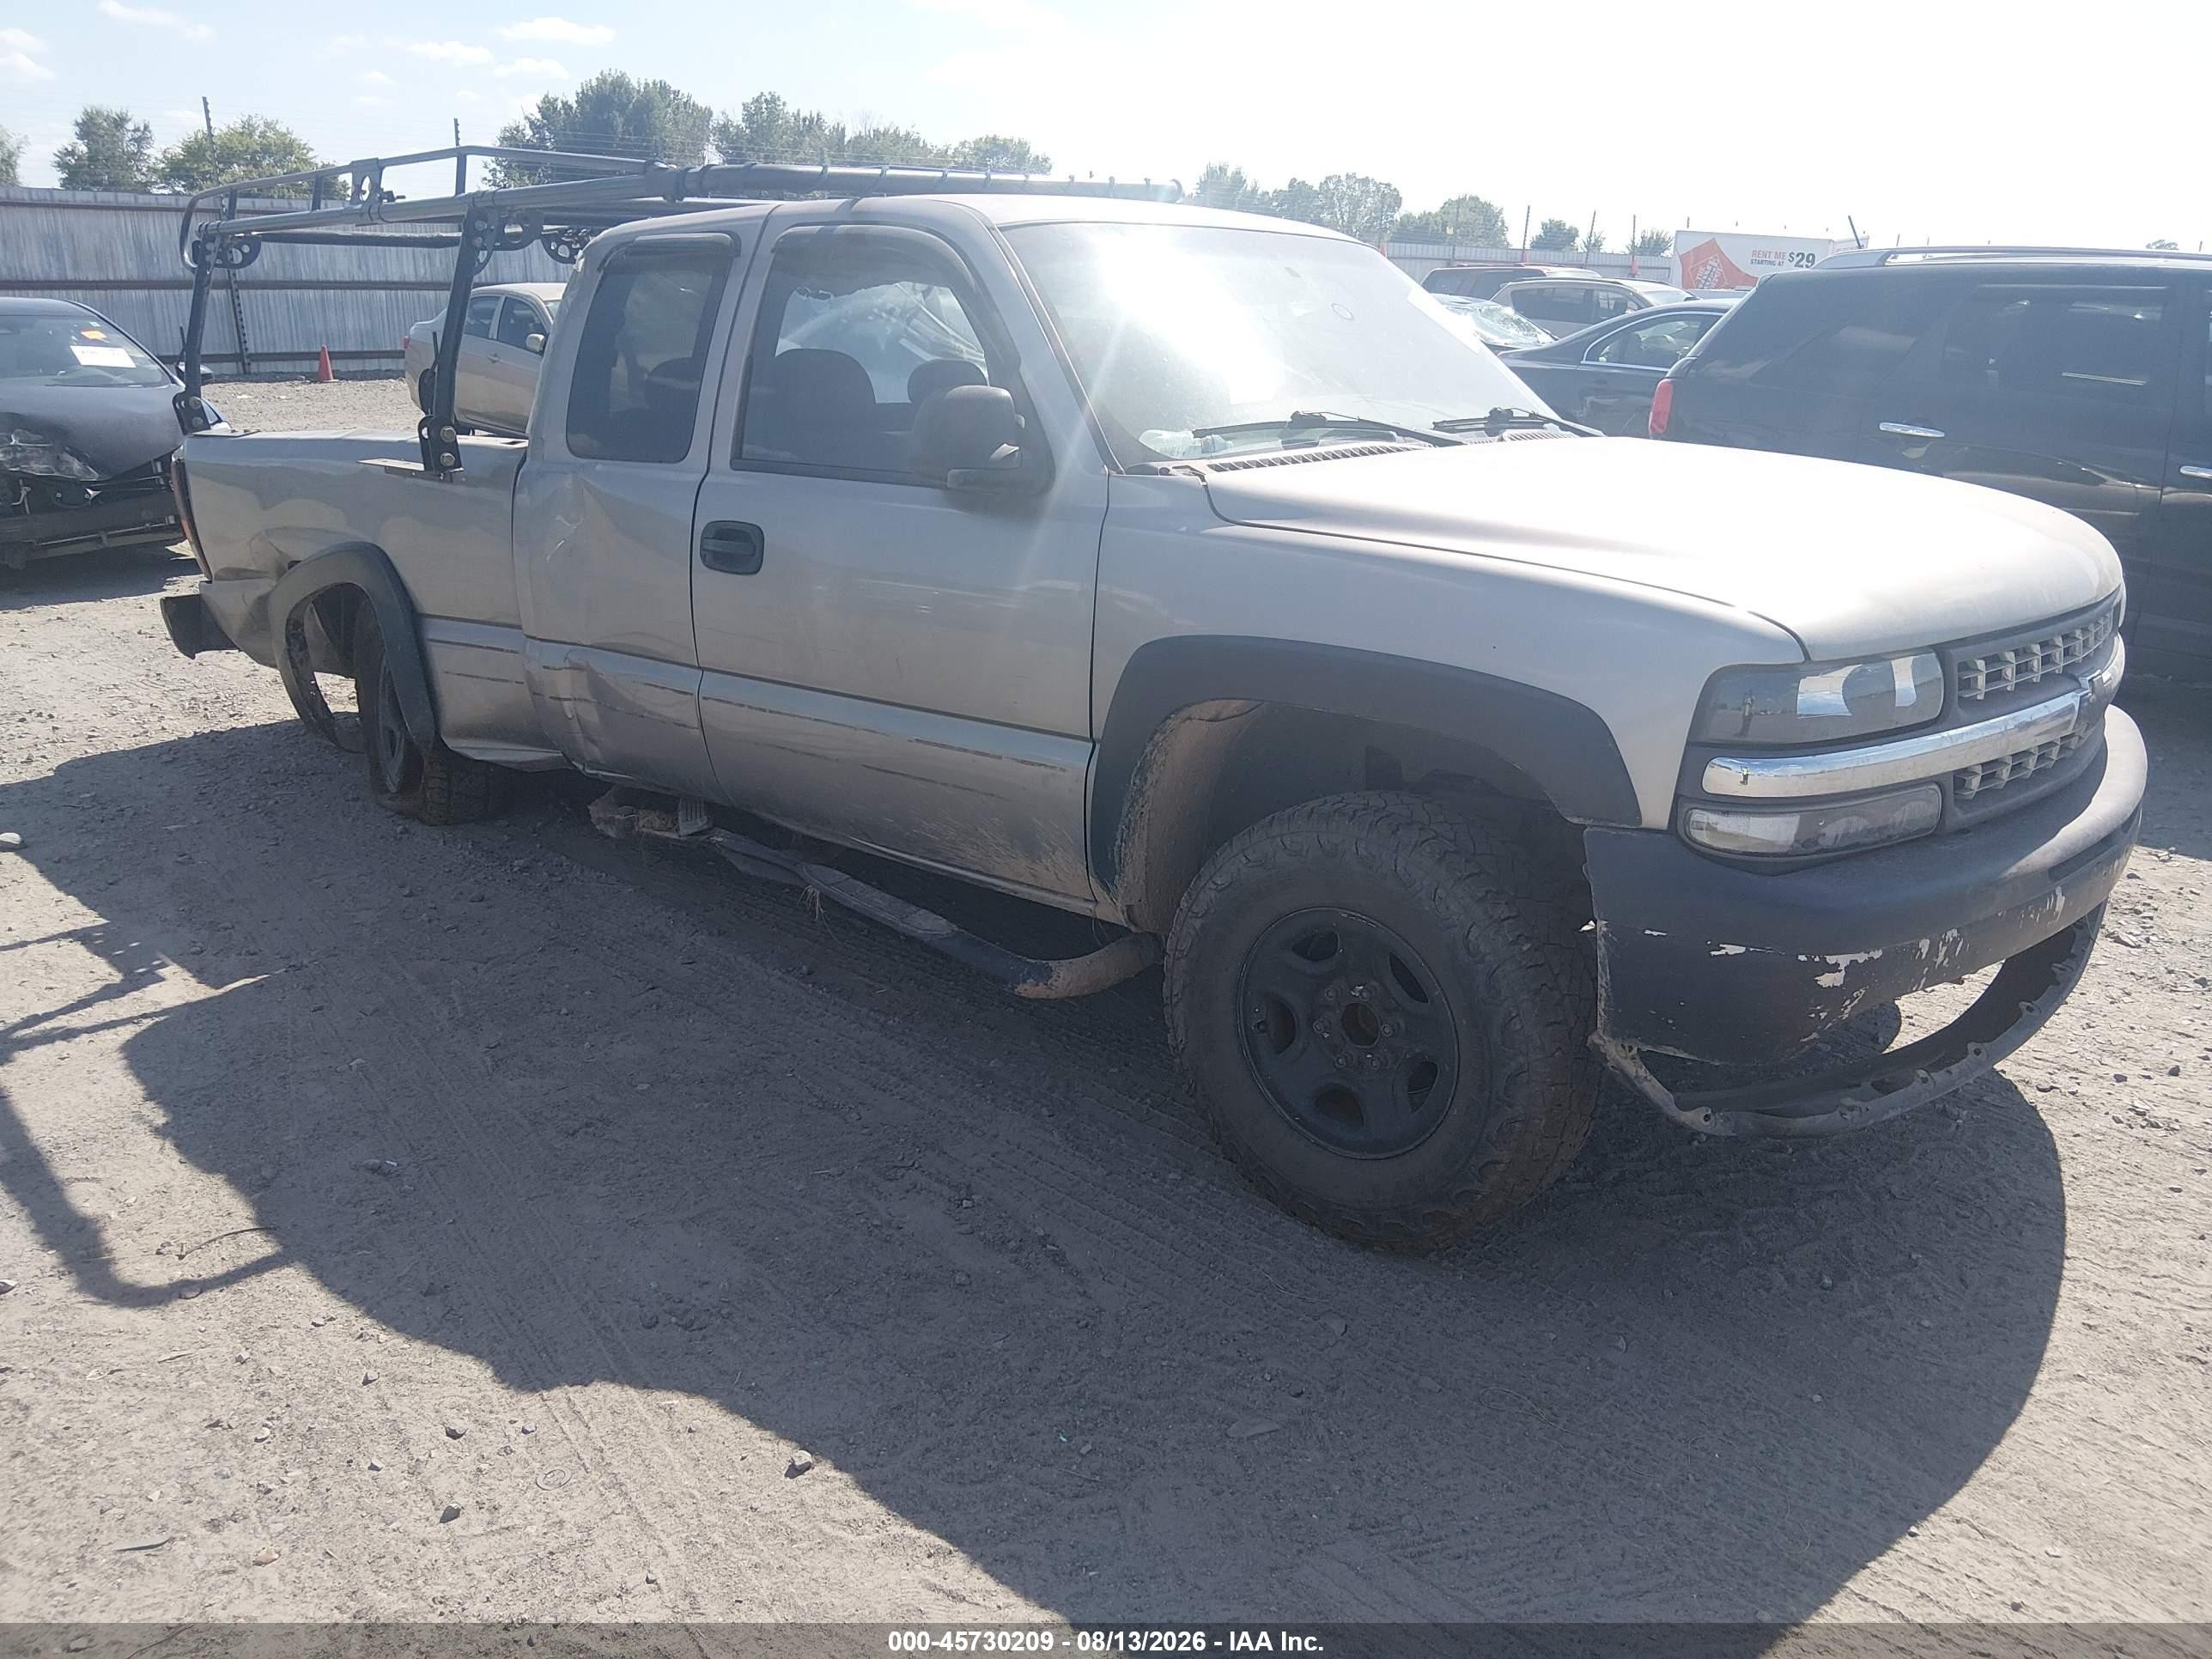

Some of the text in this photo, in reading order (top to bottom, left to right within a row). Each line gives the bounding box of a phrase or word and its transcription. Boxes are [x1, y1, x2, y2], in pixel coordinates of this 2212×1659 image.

[1751, 250, 1787, 260] RENT ME
[1788, 251, 1816, 269] $29
